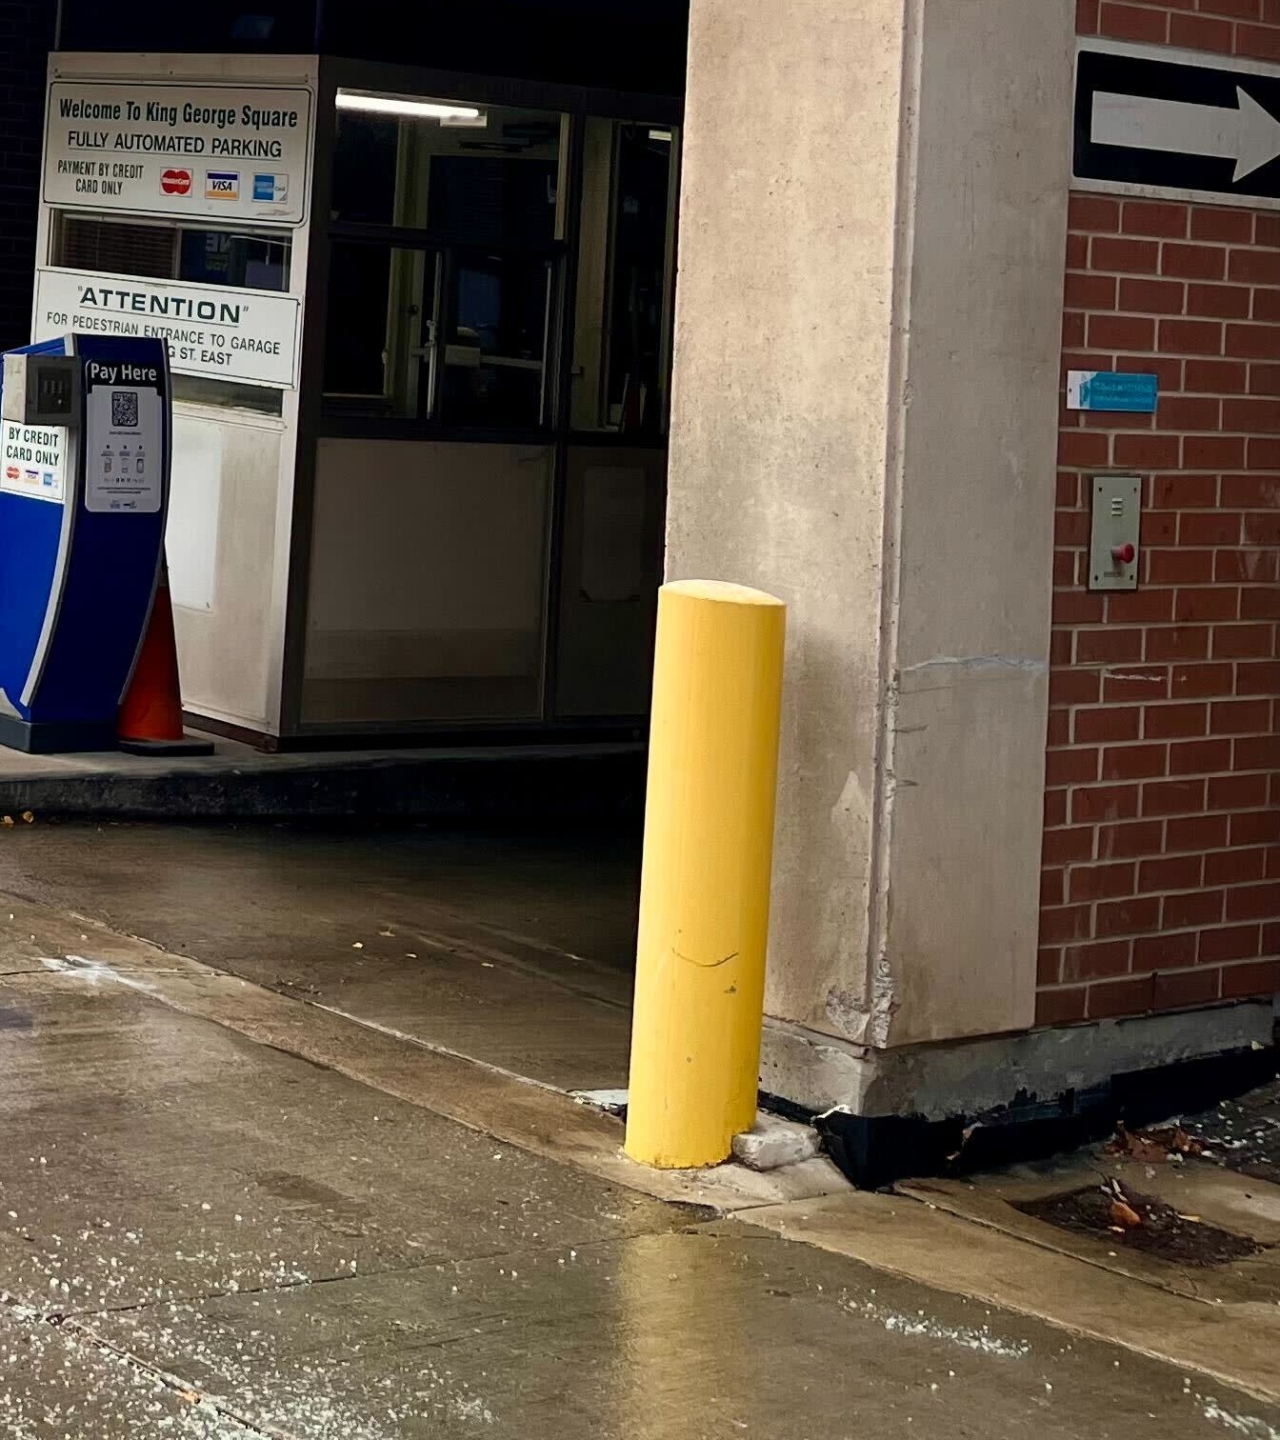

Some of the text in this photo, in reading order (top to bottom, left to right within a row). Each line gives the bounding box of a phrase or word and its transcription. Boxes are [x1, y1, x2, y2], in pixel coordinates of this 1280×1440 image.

[59, 98, 298, 130] Welcome To King George Square
[68, 131, 282, 158] FULLY AUTOMATED PARKING
[57, 160, 144, 179] PAYMENT BY CREDIT
[75, 179, 123, 196] CARD ONLY
[212, 180, 233, 191] VISA
[46, 312, 281, 355] FOR PEDESTRIAN ENTRANCE TO GARAGE
[180, 347, 197, 360] ST.
[200, 350, 232, 366] EAST
[91, 363, 157, 384] Pay Here
[8, 426, 59, 448] BY CREDIT
[6, 445, 60, 467] CARD ONLY
